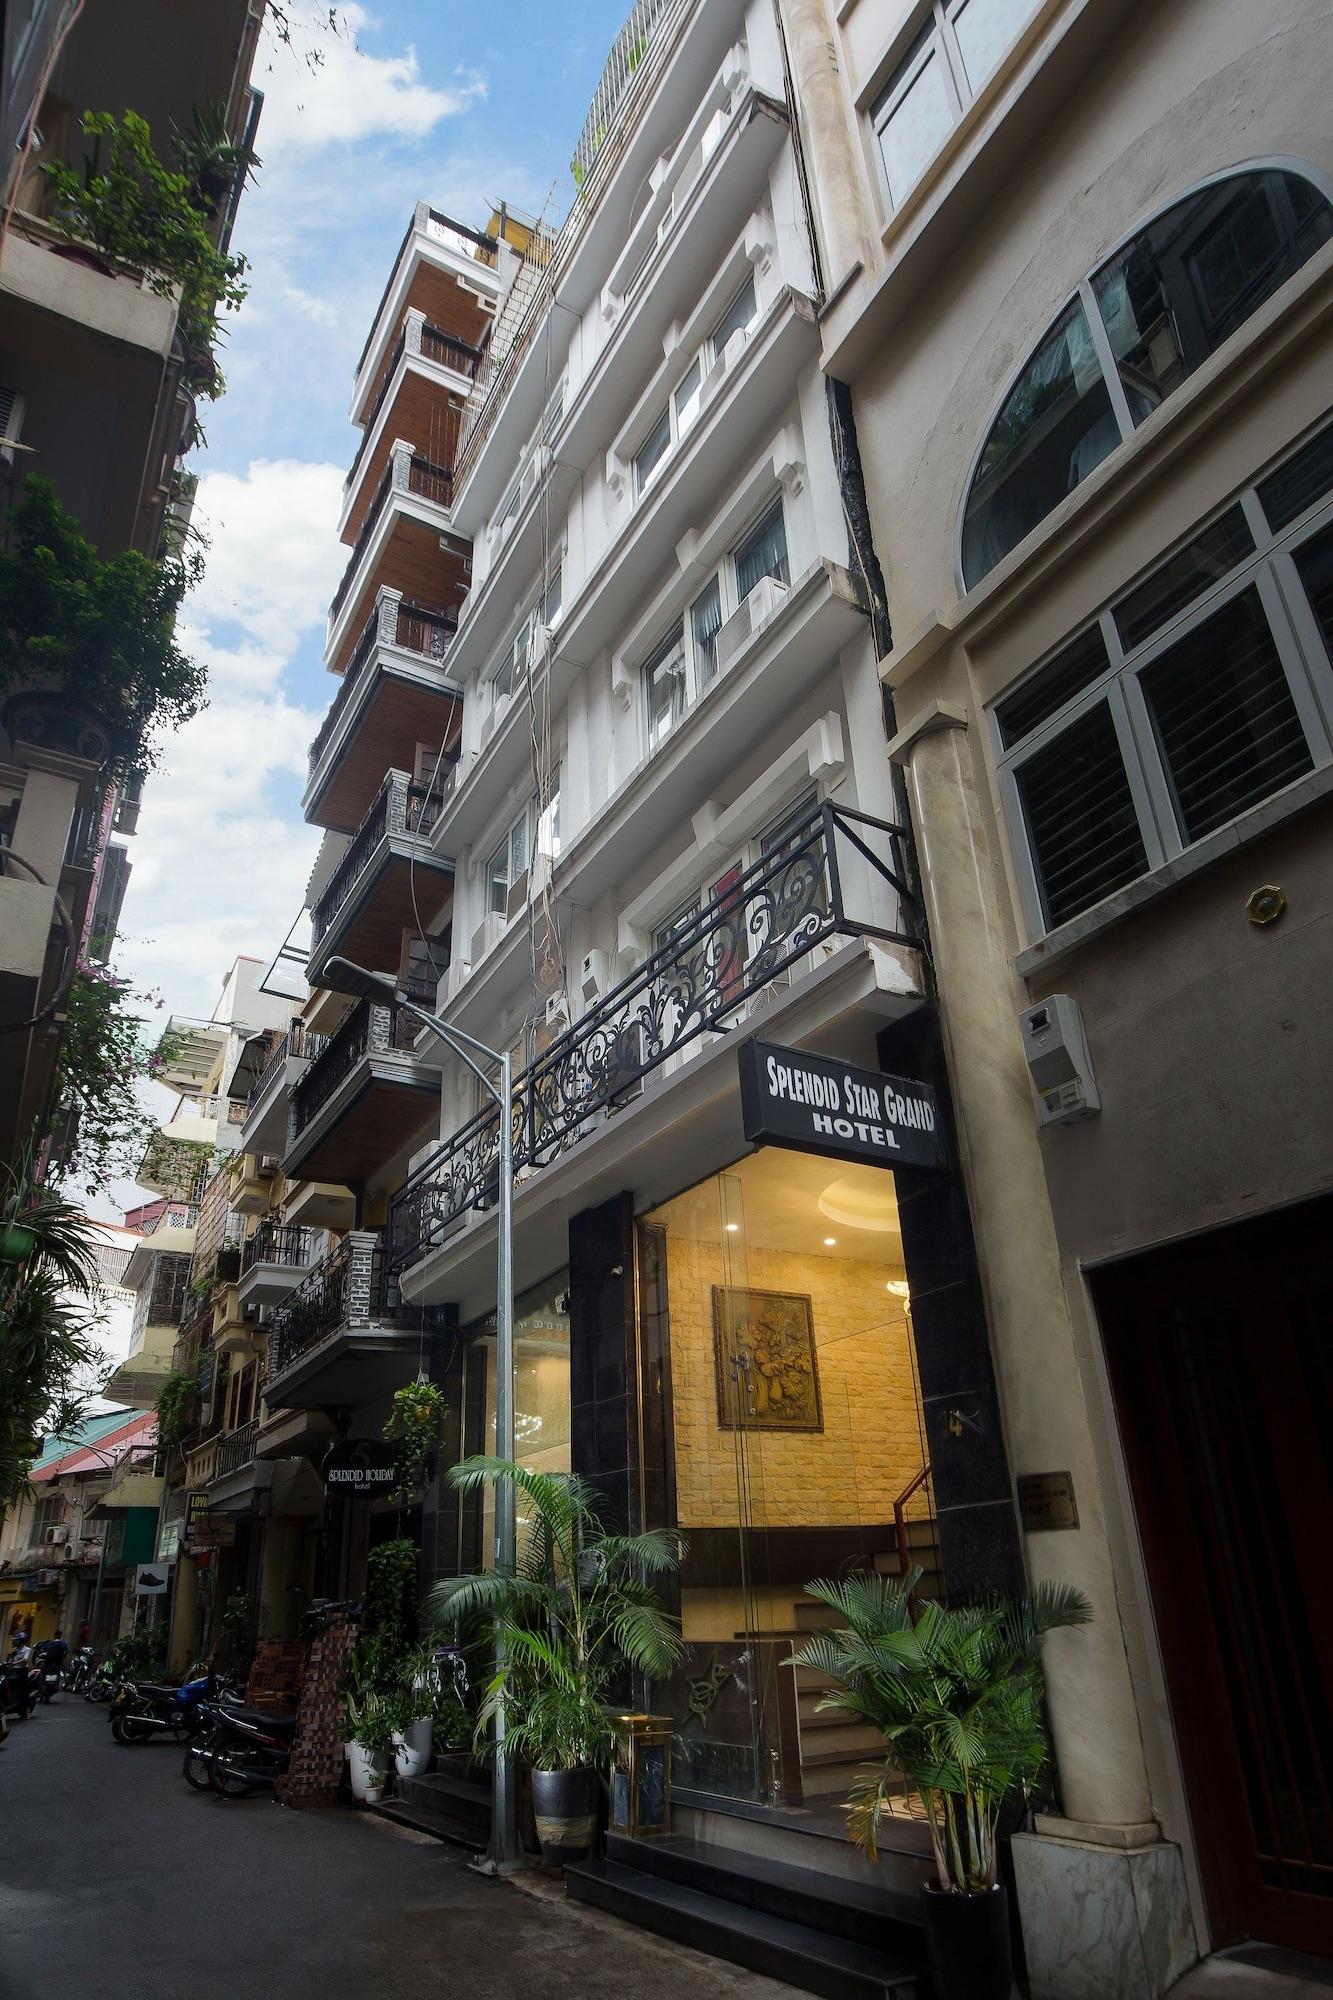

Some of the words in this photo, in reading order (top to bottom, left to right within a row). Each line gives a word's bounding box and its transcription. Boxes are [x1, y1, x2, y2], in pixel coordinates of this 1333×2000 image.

[766, 1056, 840, 1110] SPLENDID
[844, 1075, 882, 1121] STAR
[883, 1084, 935, 1132] GRAND
[812, 1112, 901, 1149] HOTEL
[328, 1469, 363, 1481] SPLENDID
[365, 1469, 394, 1481] HOLIDAY
[354, 1482, 371, 1490] hotel
